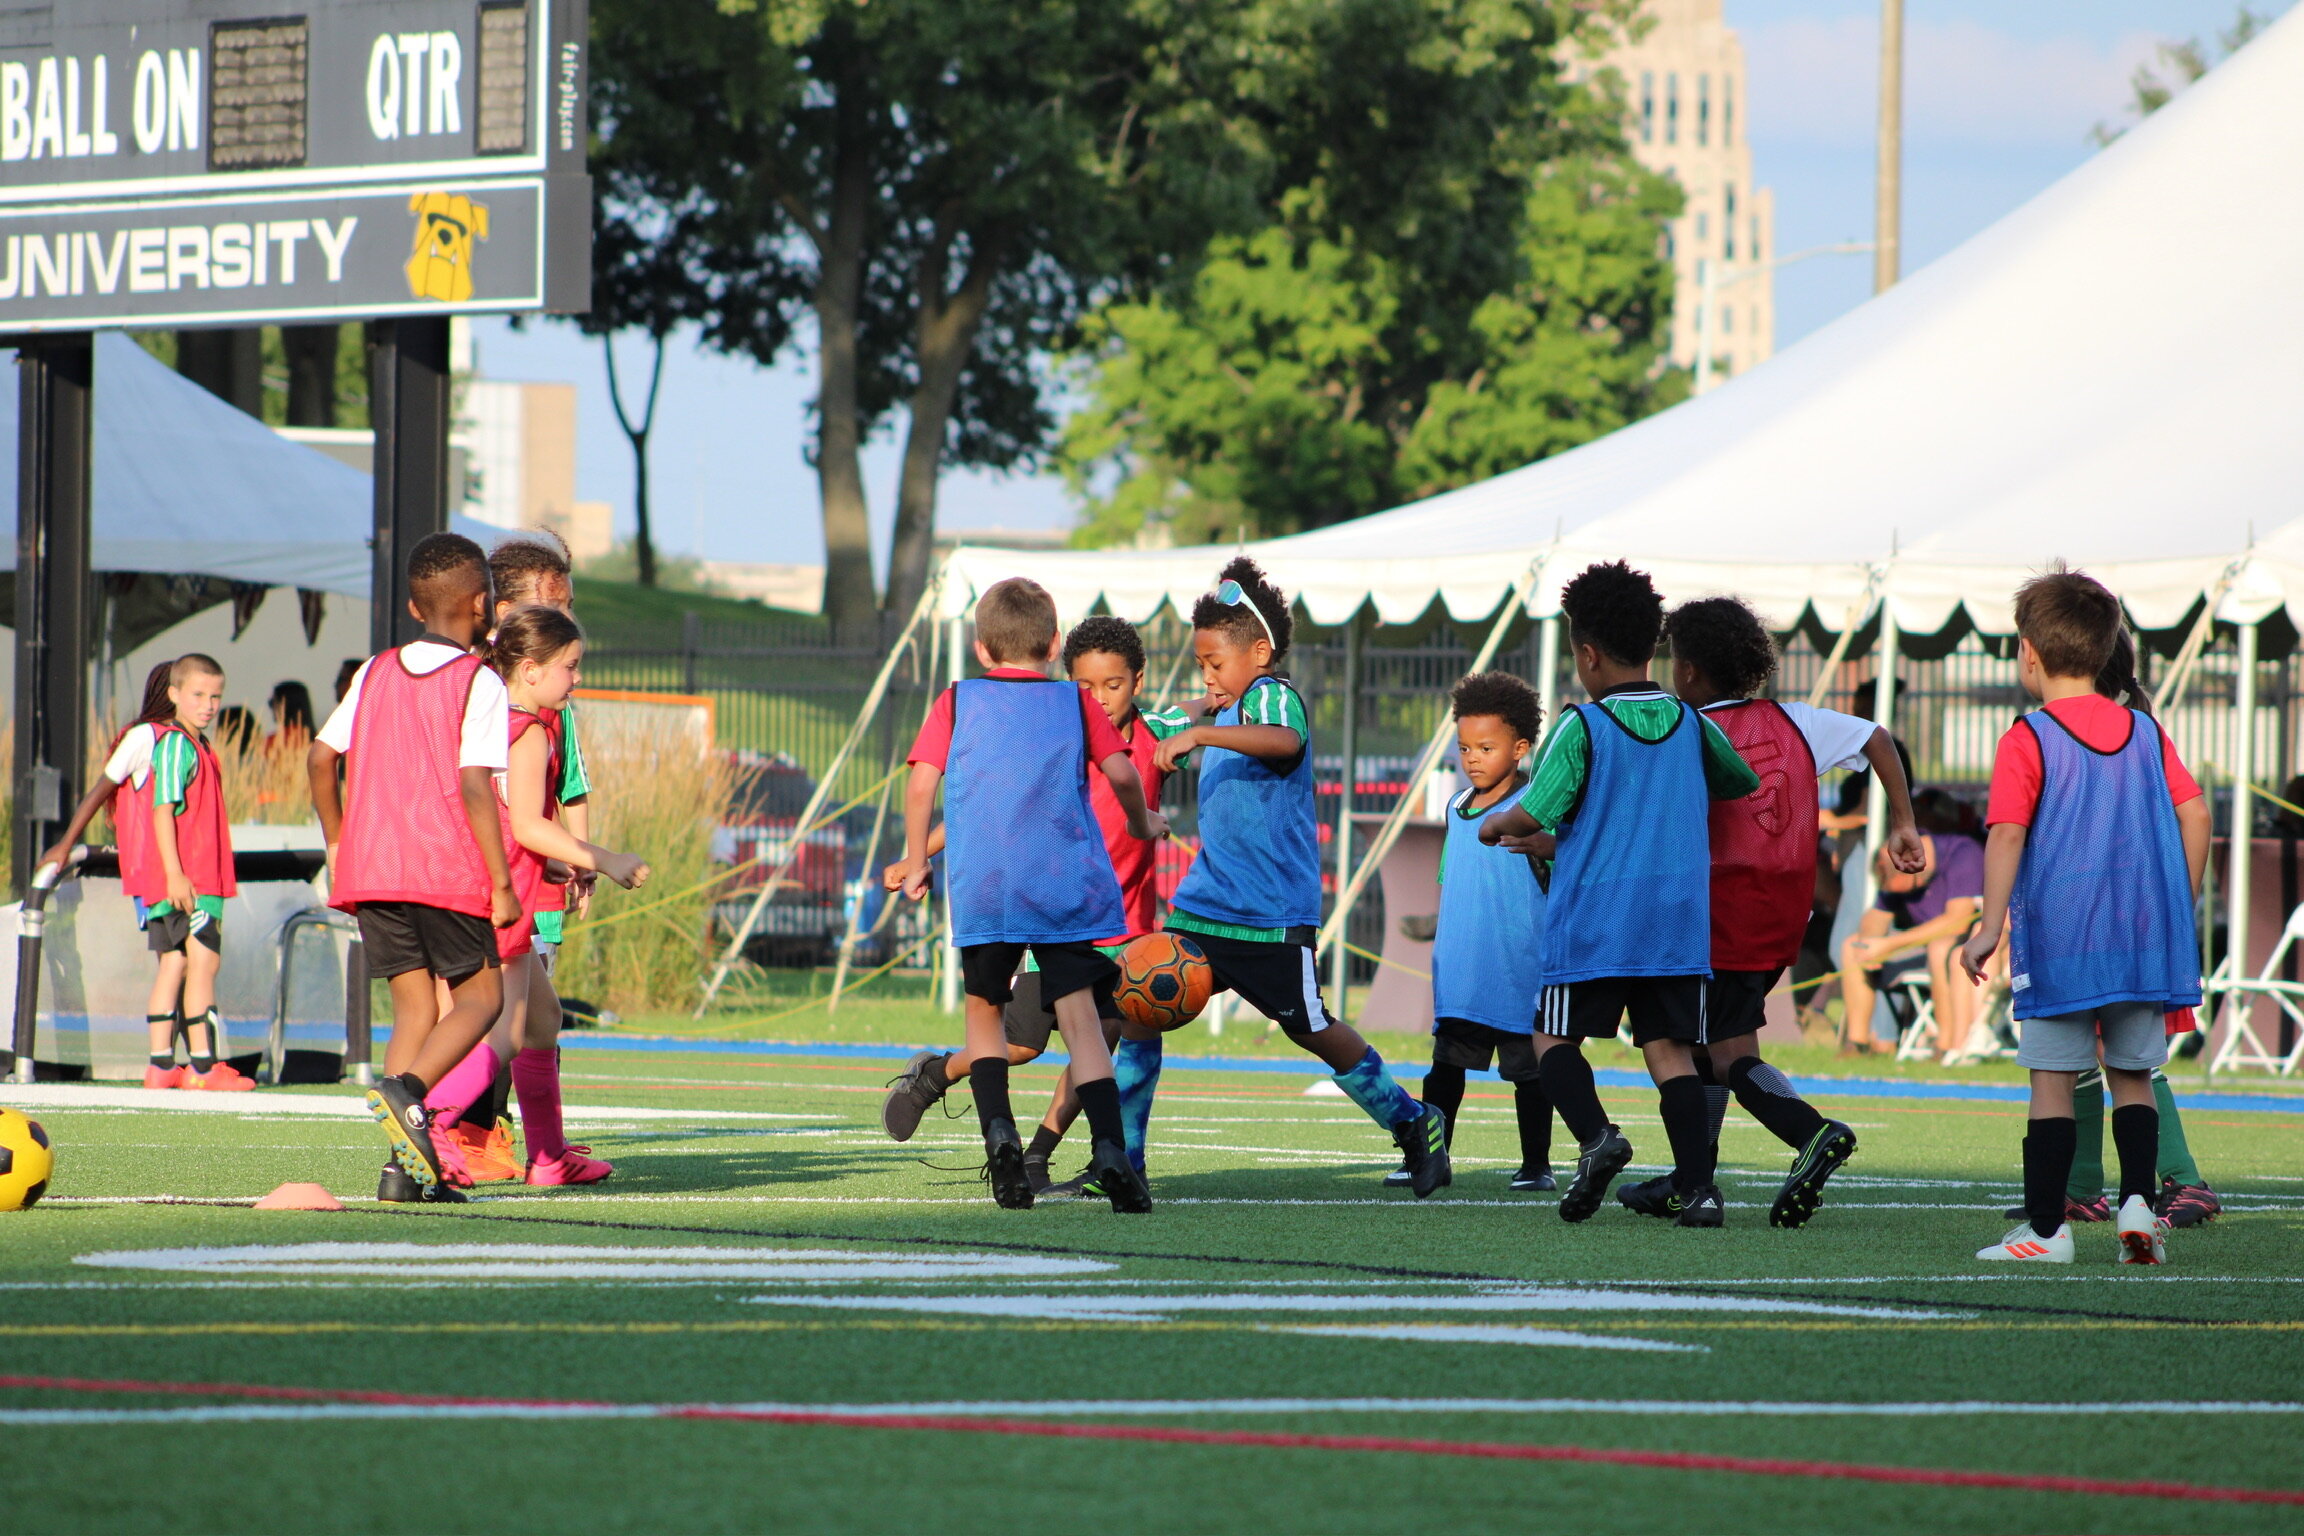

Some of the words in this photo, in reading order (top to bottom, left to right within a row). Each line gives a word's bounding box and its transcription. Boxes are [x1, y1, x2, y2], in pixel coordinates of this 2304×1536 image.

[1, 53, 118, 162] BALL
[133, 47, 200, 155] ON
[366, 30, 462, 140] QTR
[559, 42, 579, 150] fair-play.com
